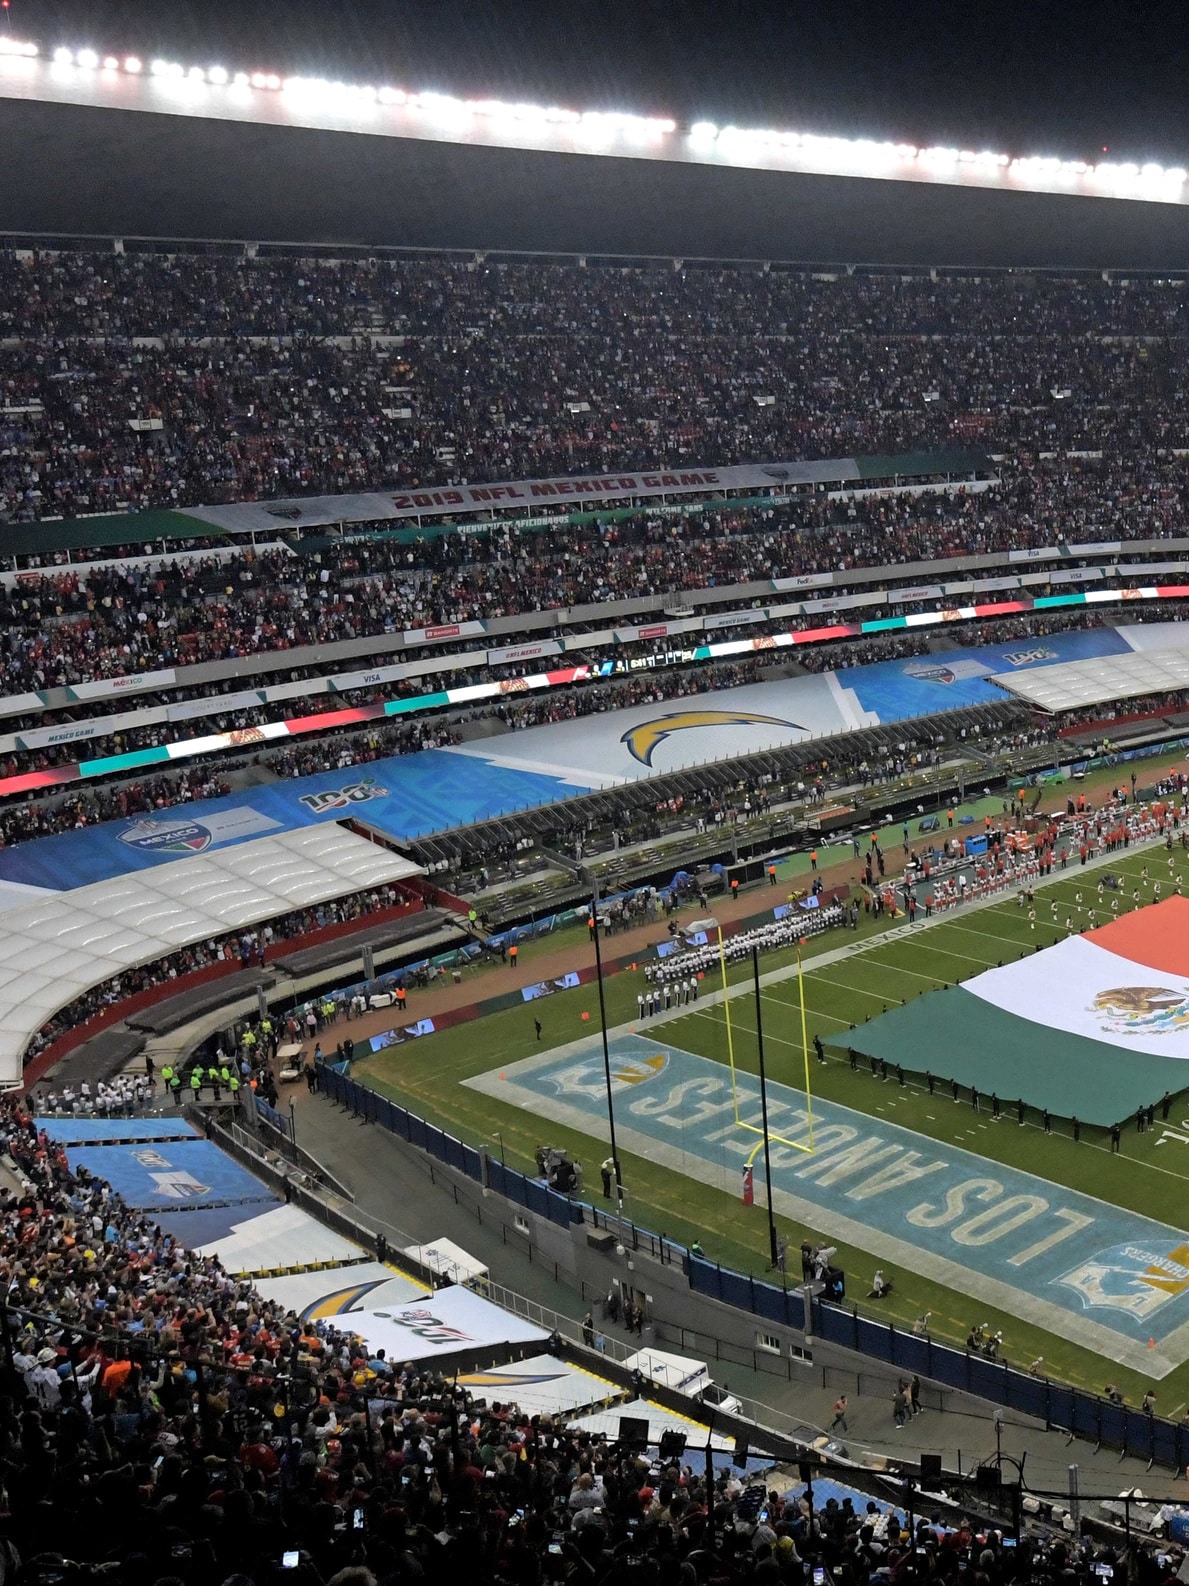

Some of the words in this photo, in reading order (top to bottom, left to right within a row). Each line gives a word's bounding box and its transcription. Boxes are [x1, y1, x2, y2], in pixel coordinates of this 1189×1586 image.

[392, 490, 464, 510] 2019
[469, 486, 524, 502] NFL
[530, 477, 638, 497] MEXICO
[642, 471, 720, 489] GAME
[1069, 572, 1082, 580] VISA
[364, 674, 380, 682] VISA
[48, 731, 75, 742] MEXICO
[75, 728, 94, 738] GAME
[139, 828, 200, 846] MEXICO
[848, 923, 925, 951] MEXICO
[629, 1076, 949, 1201] ANGELES
[906, 1177, 1095, 1267] LOS
